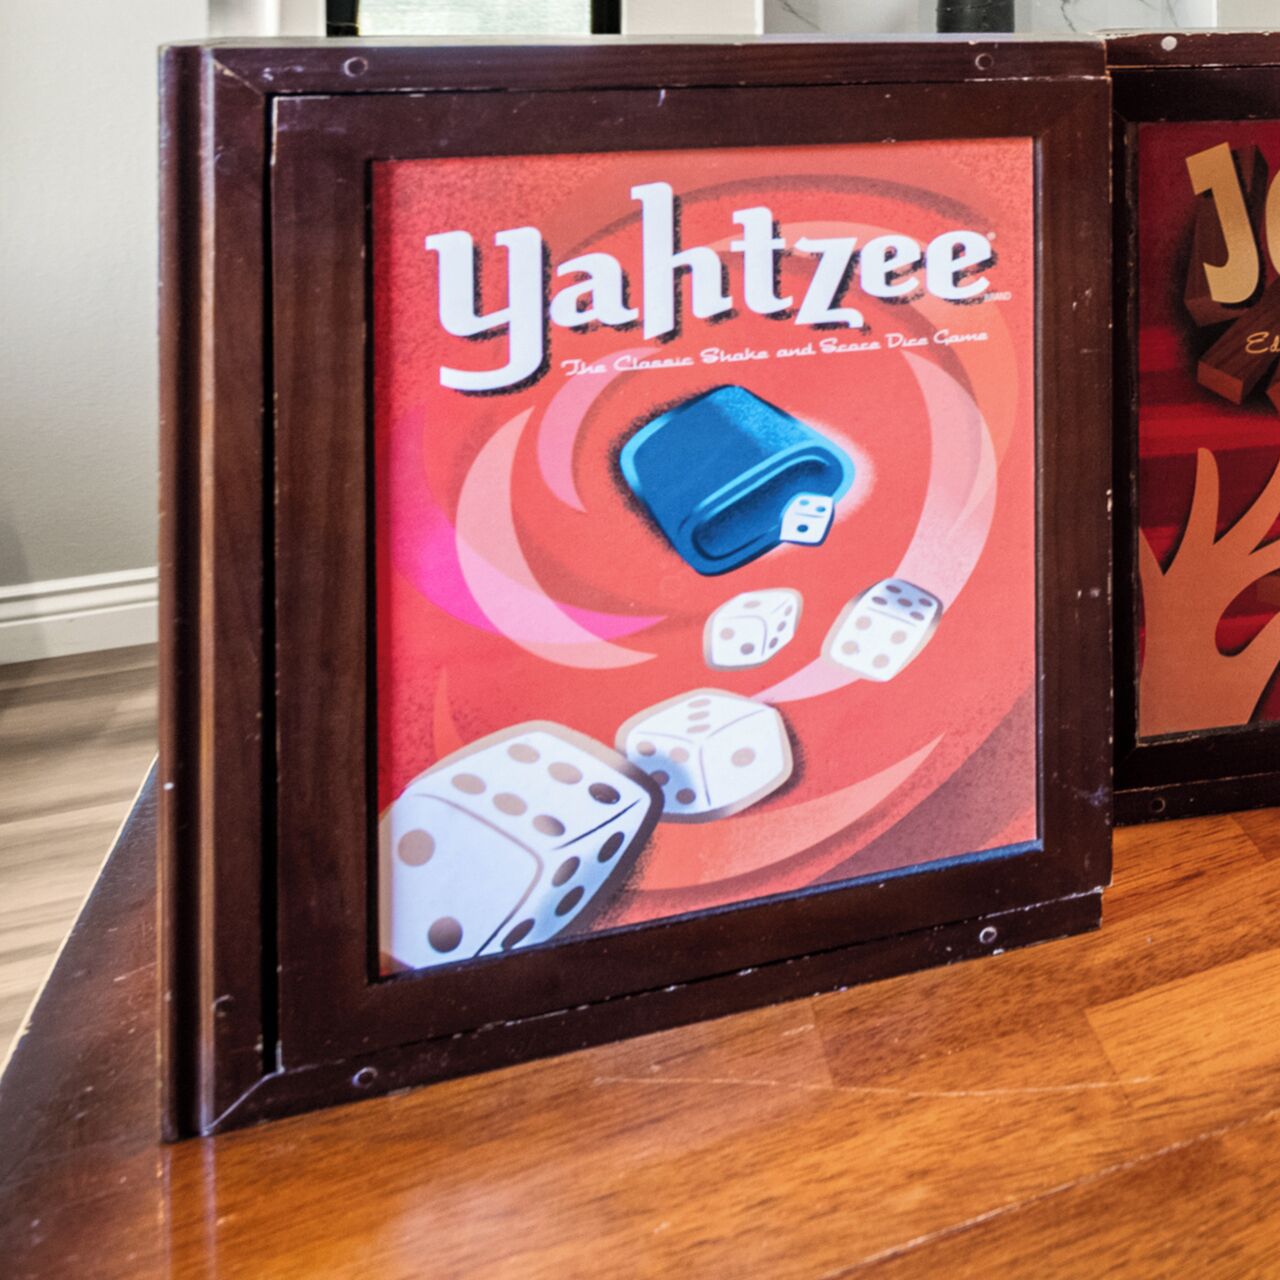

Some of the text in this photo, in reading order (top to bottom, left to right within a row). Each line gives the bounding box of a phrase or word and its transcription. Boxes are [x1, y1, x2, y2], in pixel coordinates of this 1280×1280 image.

[561, 329, 988, 376] The Classic Shake and Score Dice Game
